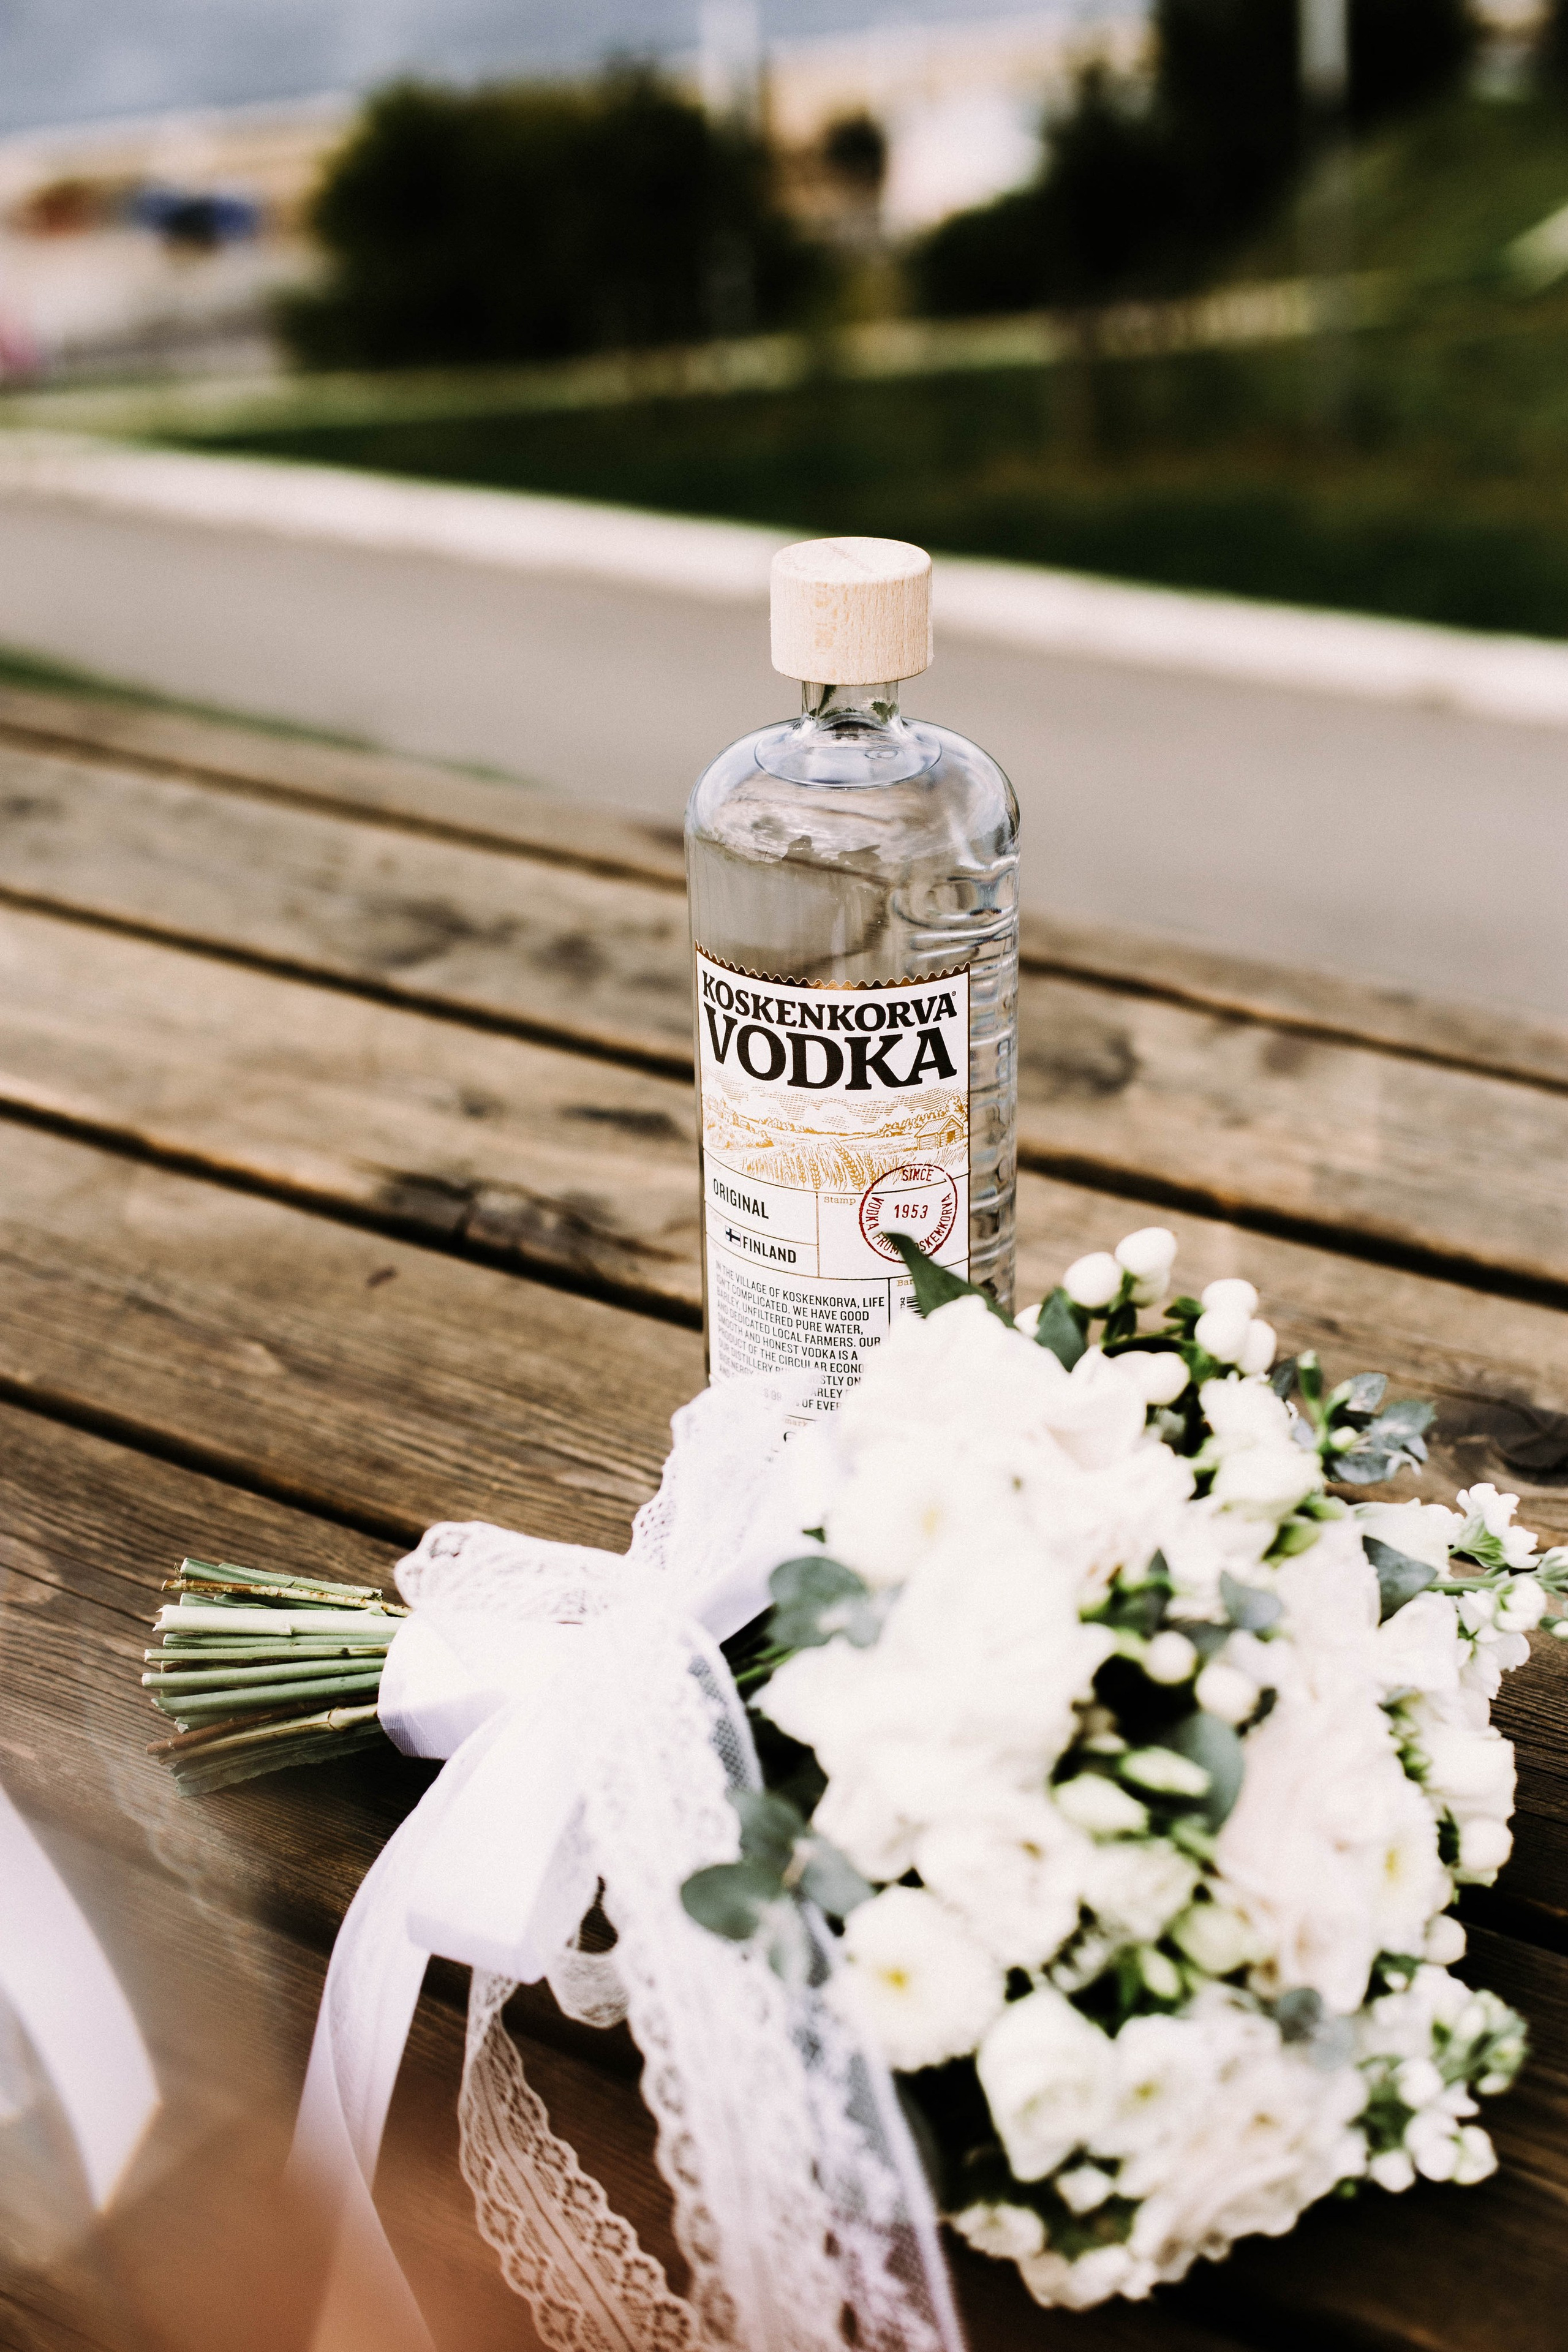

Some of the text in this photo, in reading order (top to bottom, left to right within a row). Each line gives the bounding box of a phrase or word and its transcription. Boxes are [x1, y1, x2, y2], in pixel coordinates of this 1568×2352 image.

[704, 1001, 957, 1090] VODKA
[902, 1169, 934, 1182] SINCE
[713, 1178, 769, 1219] ORIGINAL
[824, 1196, 856, 1205] Stamp
[894, 1204, 928, 1218] 1953
[865, 1193, 953, 1255] VODKA FROM SKENKORVA
[743, 1235, 797, 1264] FINLAND
[716, 1260, 885, 1309] IN THE VILLAGE OF KOSKENKORVA, LIFE
[732, 1284, 790, 1314] COMPLICATED.
[793, 1305, 808, 1317] WE
[811, 1308, 837, 1320] HAVE
[840, 1311, 870, 1321] GOOD
[717, 1300, 881, 1348] AND DEDICATED LOCAL FARMERS. OUR
[718, 1312, 858, 1360] SMOOTH AND HONEST VODKA IS A
[742, 1303, 793, 1327] UNFILTERED
[796, 1319, 822, 1332] PURE
[824, 1323, 864, 1335] WATER,
[718, 1325, 746, 1351] PRODUCT
[748, 1344, 758, 1355] OF
[760, 1349, 776, 1362] THE
[778, 1354, 827, 1372] CIRCULAR
[830, 1363, 864, 1374] ECONO
[731, 1346, 774, 1373] DISTILLERY
[814, 1375, 844, 1386] STLY
[802, 1398, 814, 1408] OF
[810, 1388, 843, 1398] ARLEY
